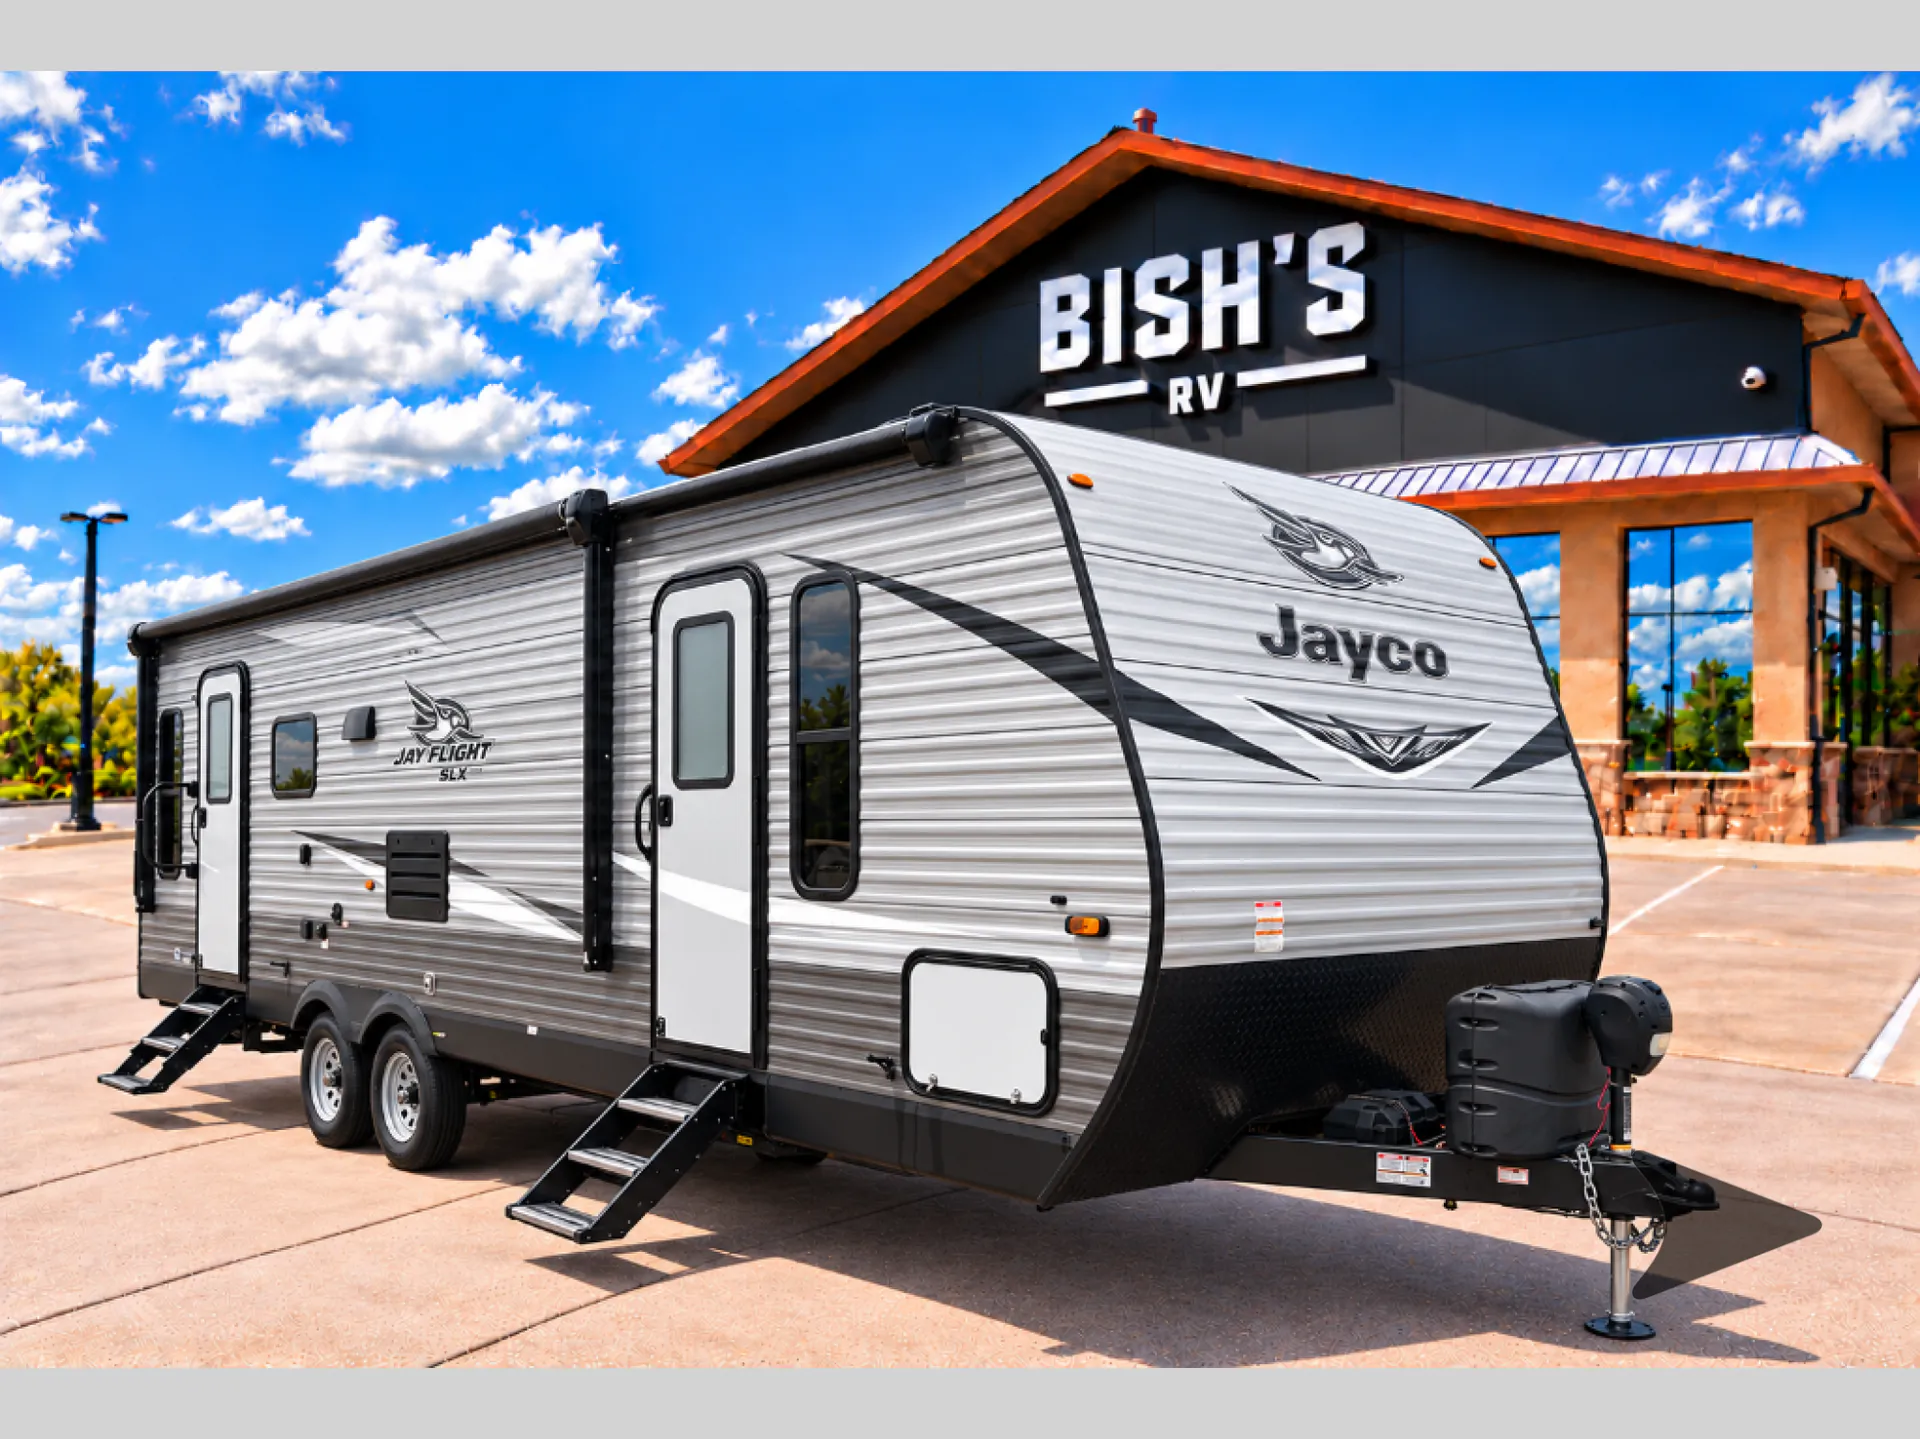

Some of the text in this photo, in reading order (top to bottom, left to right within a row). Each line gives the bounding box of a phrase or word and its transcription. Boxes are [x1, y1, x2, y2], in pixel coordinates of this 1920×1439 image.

[1039, 221, 1367, 374] BISH'S
[1168, 372, 1225, 416] RV
[1256, 603, 1450, 684] Jayco
[393, 741, 492, 765] JAY FLIGHT
[438, 767, 468, 781] SLX
